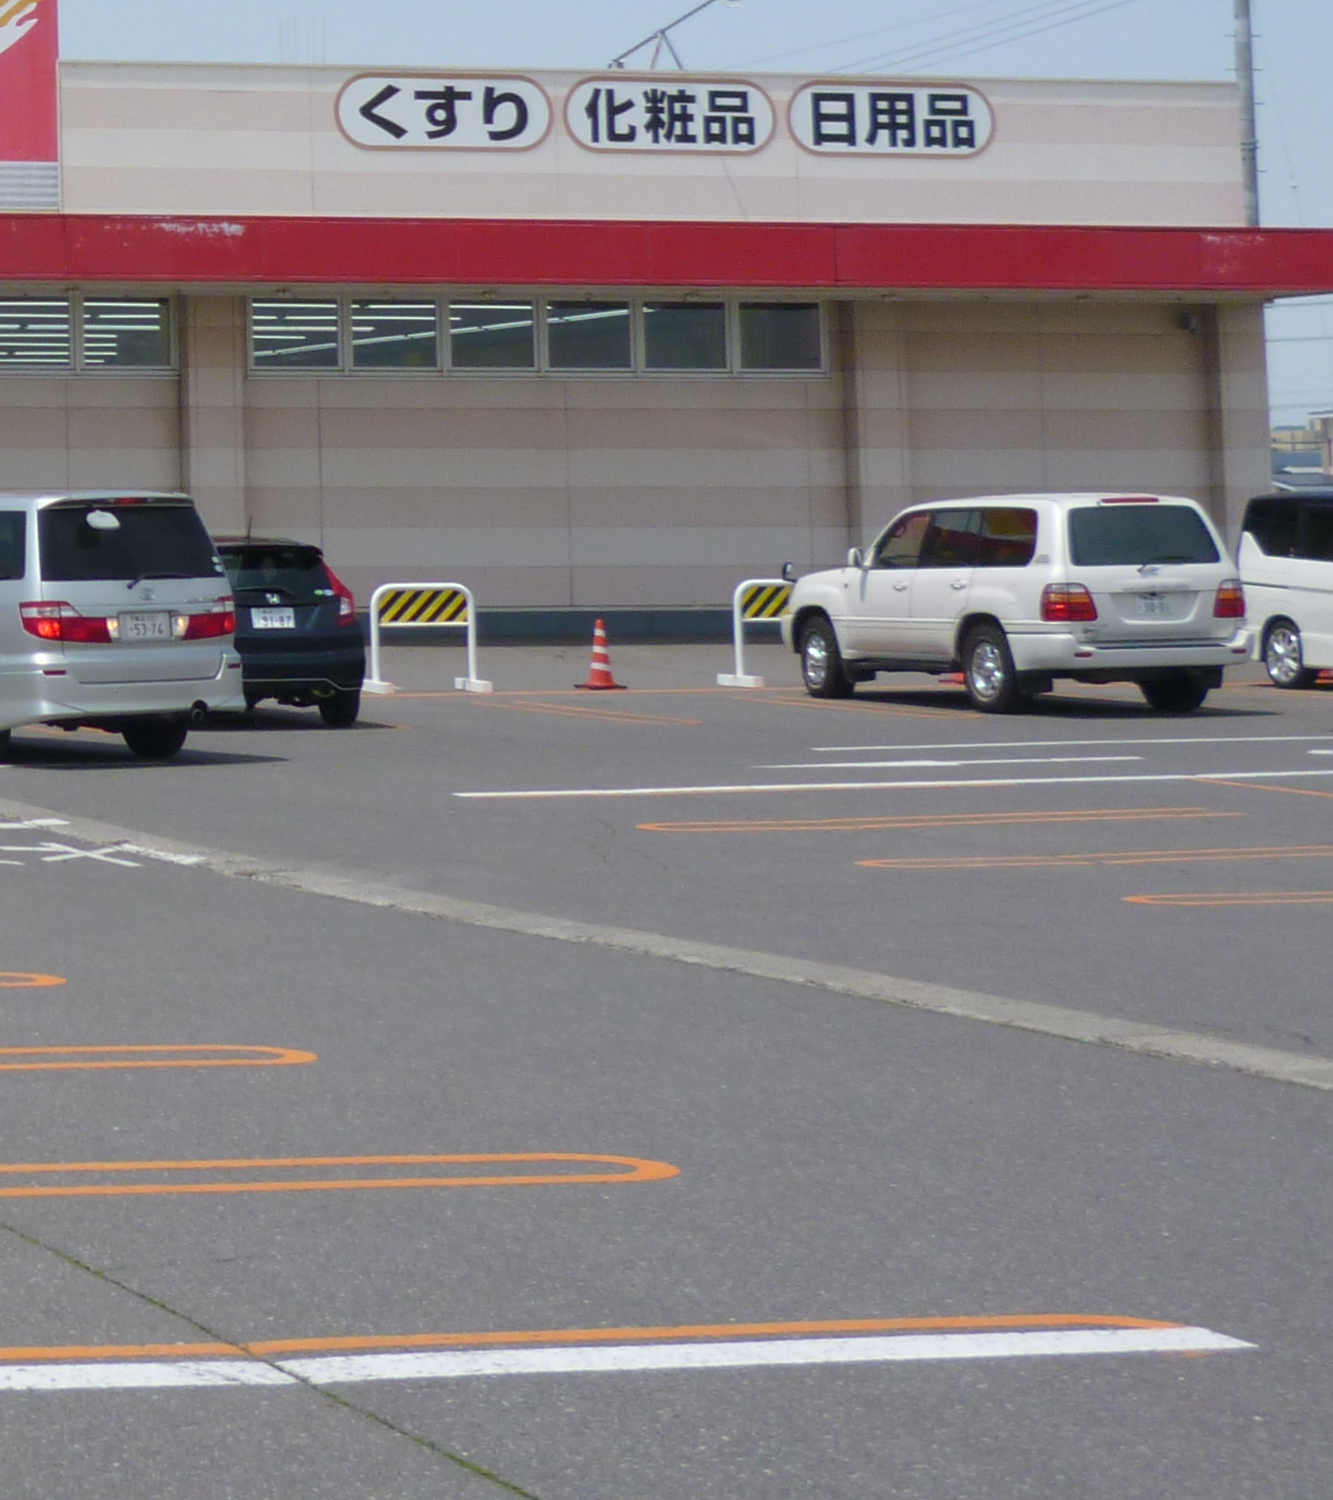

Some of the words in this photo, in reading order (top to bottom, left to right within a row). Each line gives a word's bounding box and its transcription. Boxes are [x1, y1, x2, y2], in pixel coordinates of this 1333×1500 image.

[357, 85, 530, 141] くすり
[584, 88, 756, 146] 化粧品
[811, 92, 977, 149] 日用品
